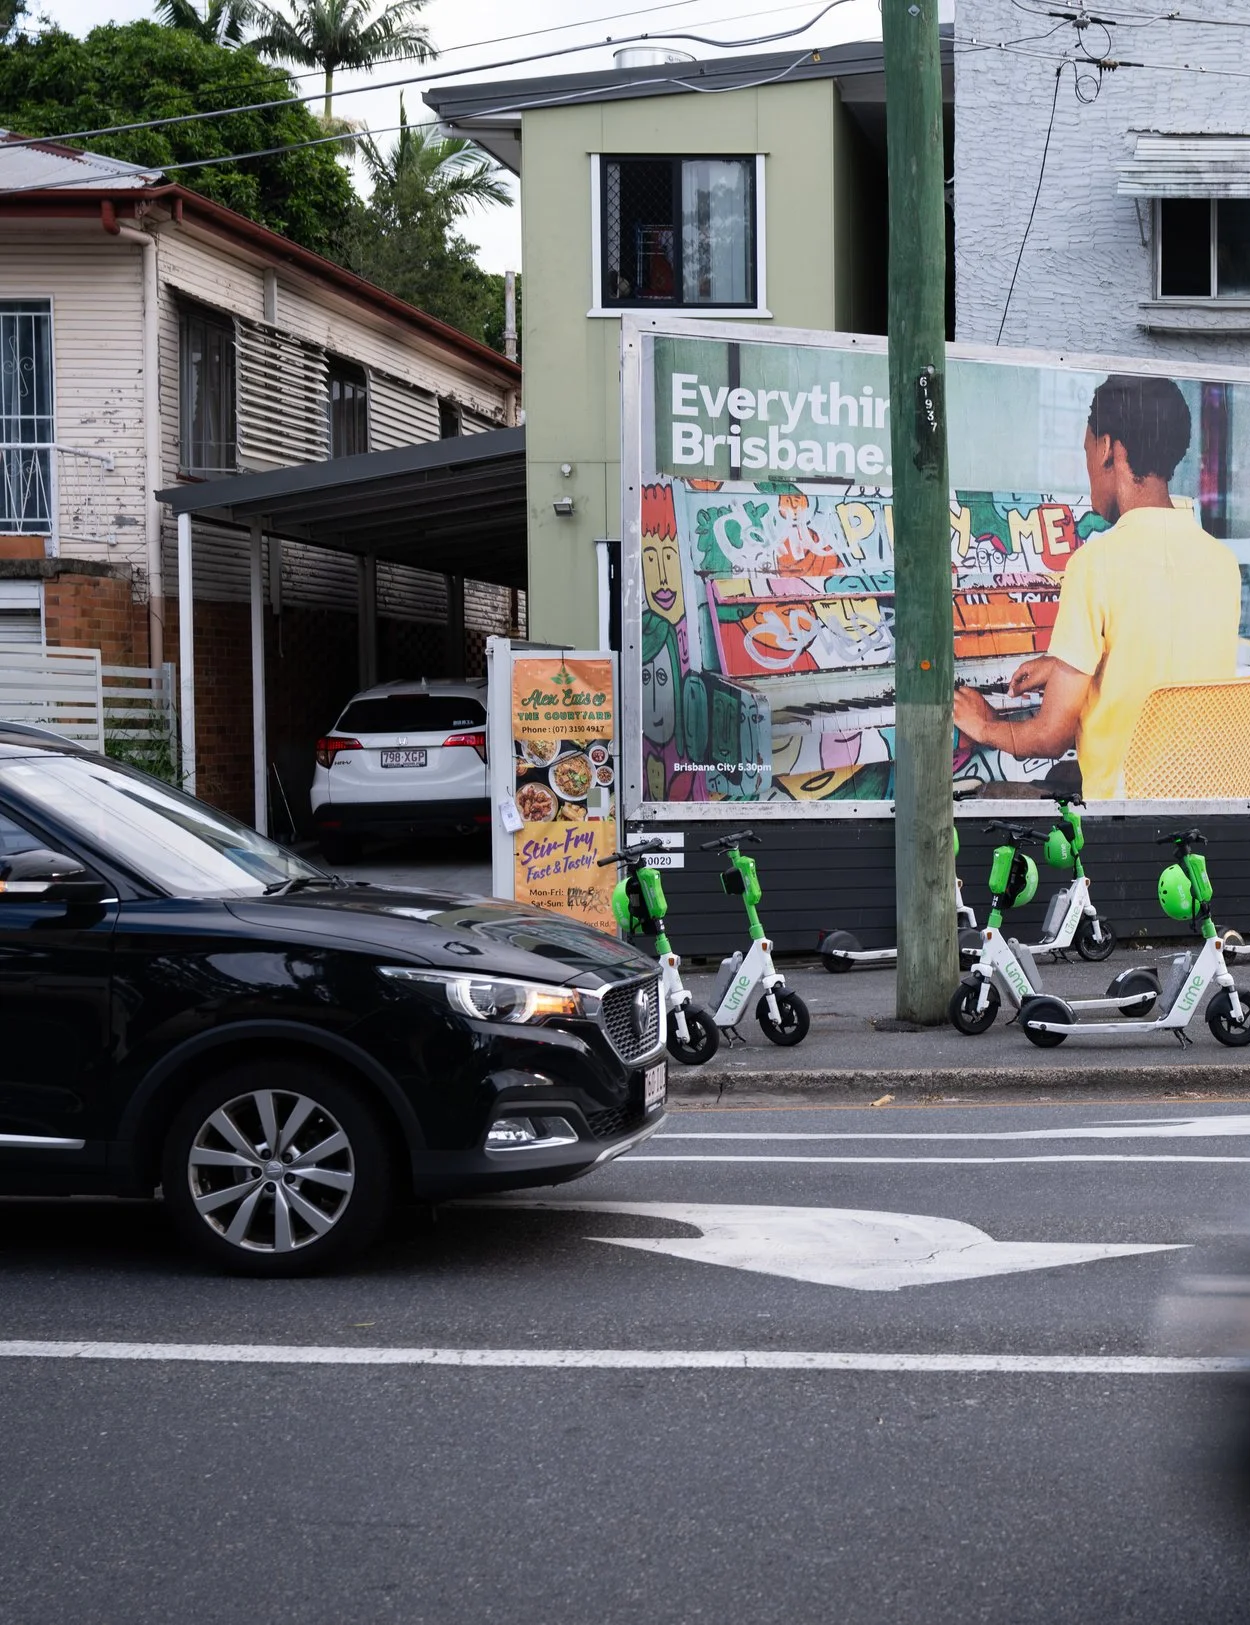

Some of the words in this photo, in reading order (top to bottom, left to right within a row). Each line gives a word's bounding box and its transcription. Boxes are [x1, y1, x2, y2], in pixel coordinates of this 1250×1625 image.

[672, 372, 890, 433] Everythin
[920, 376, 938, 433] 61937
[1008, 506, 1071, 556] ME
[517, 712, 540, 721] THE
[544, 711, 612, 720] COURTYARD
[521, 688, 559, 710] Alex
[586, 725, 605, 733] 4917
[673, 762, 715, 772] Brisbane
[716, 762, 737, 774] City
[738, 762, 772, 774] 5.30pm
[520, 826, 595, 866] Stir-Fry
[526, 864, 551, 884] Fast
[553, 860, 561, 874] &
[562, 848, 598, 873] Tasty!
[531, 900, 564, 908] Sat-Sun:
[724, 975, 750, 1011] Lime
[1004, 961, 1030, 999] Lime
[1177, 975, 1204, 1012] Lime
